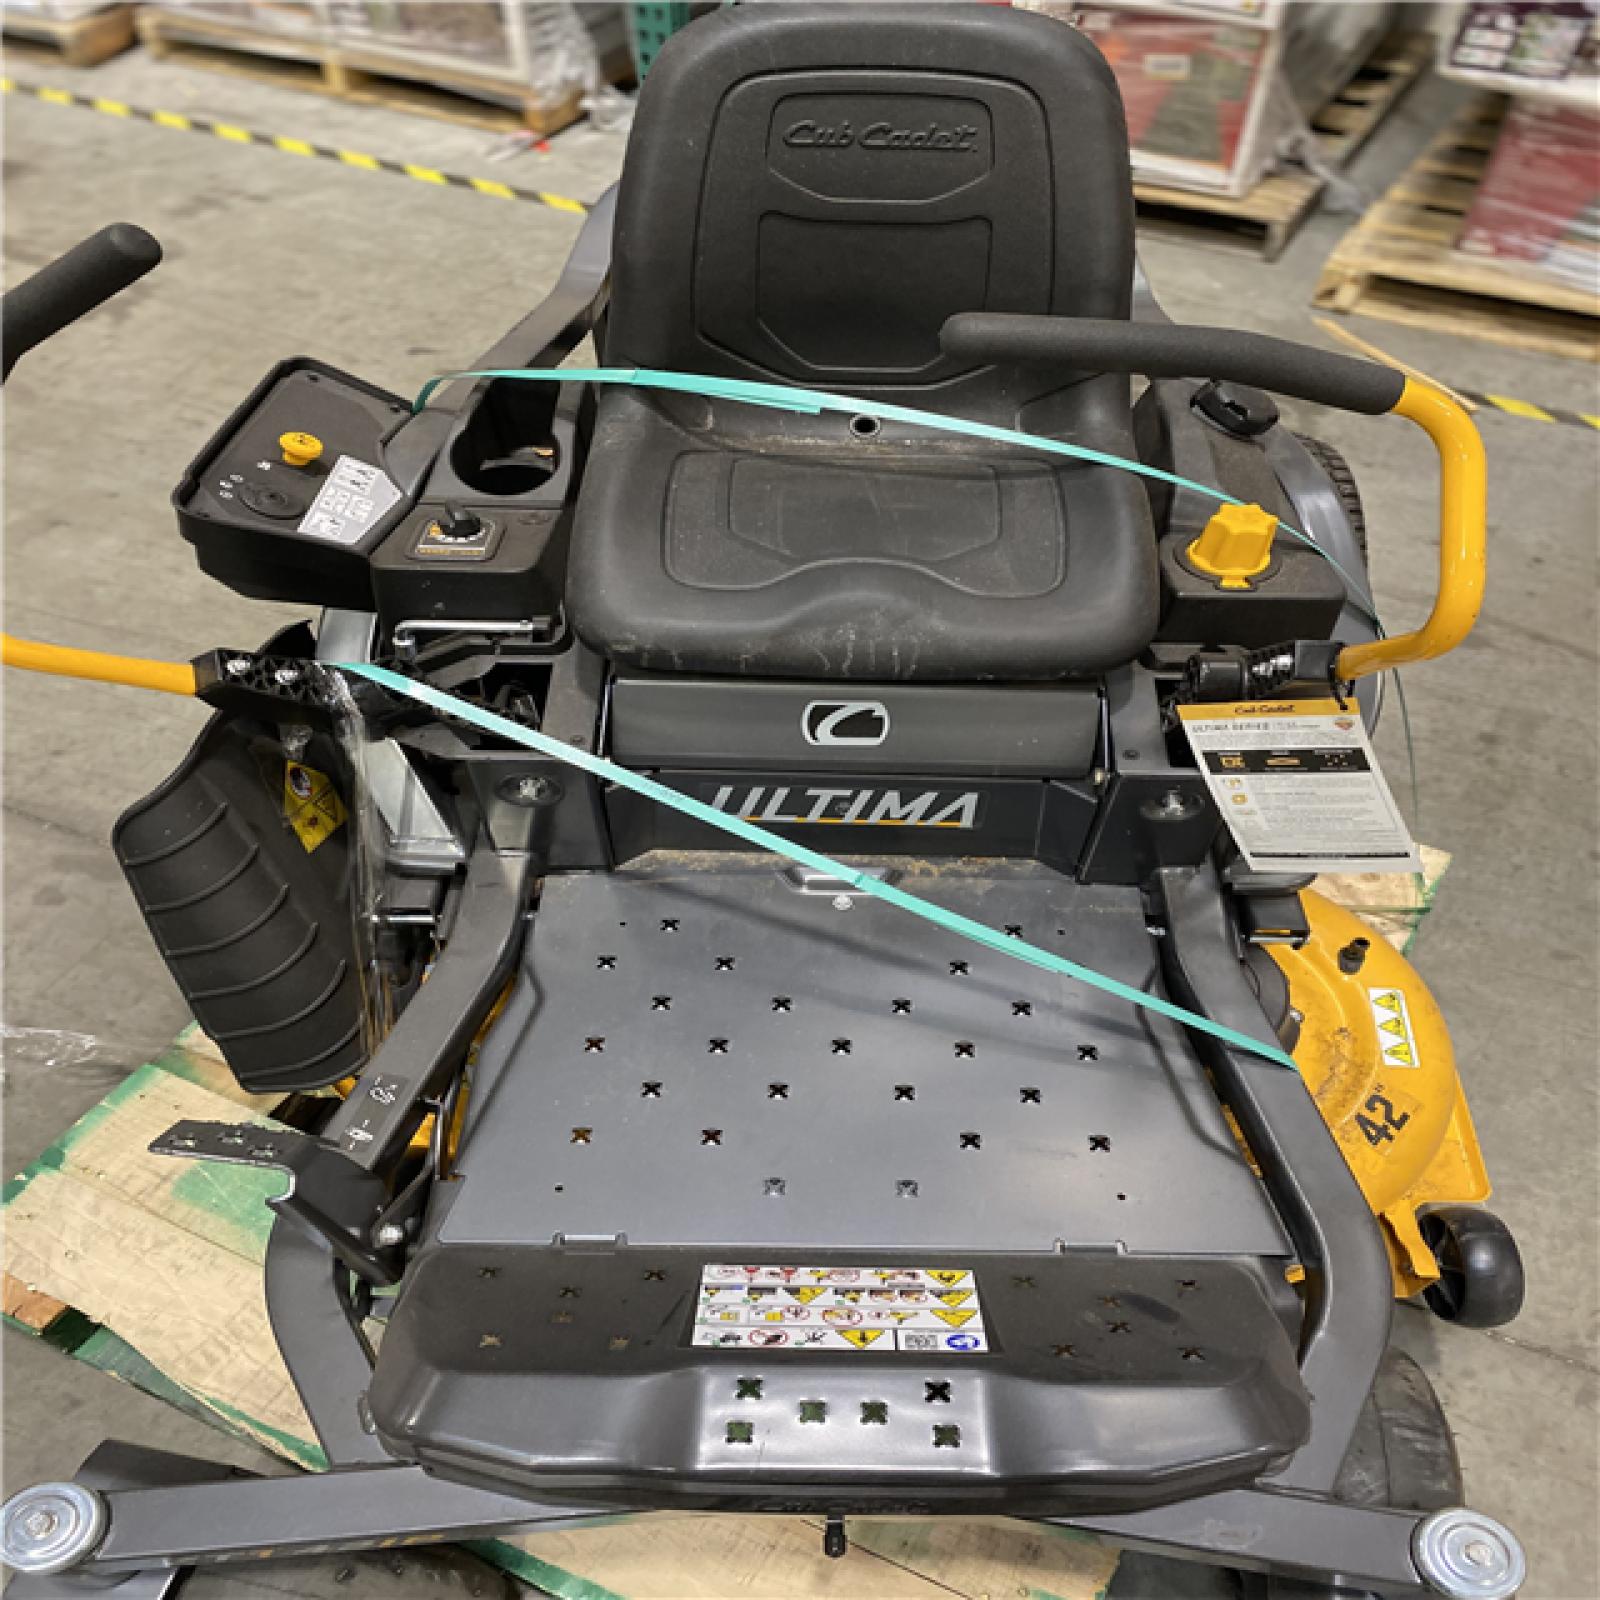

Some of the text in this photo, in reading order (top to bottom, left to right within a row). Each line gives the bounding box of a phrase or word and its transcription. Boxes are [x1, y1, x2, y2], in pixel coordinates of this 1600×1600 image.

[784, 119, 977, 150] Cub Cadet
[711, 785, 979, 829] ULTIMA
